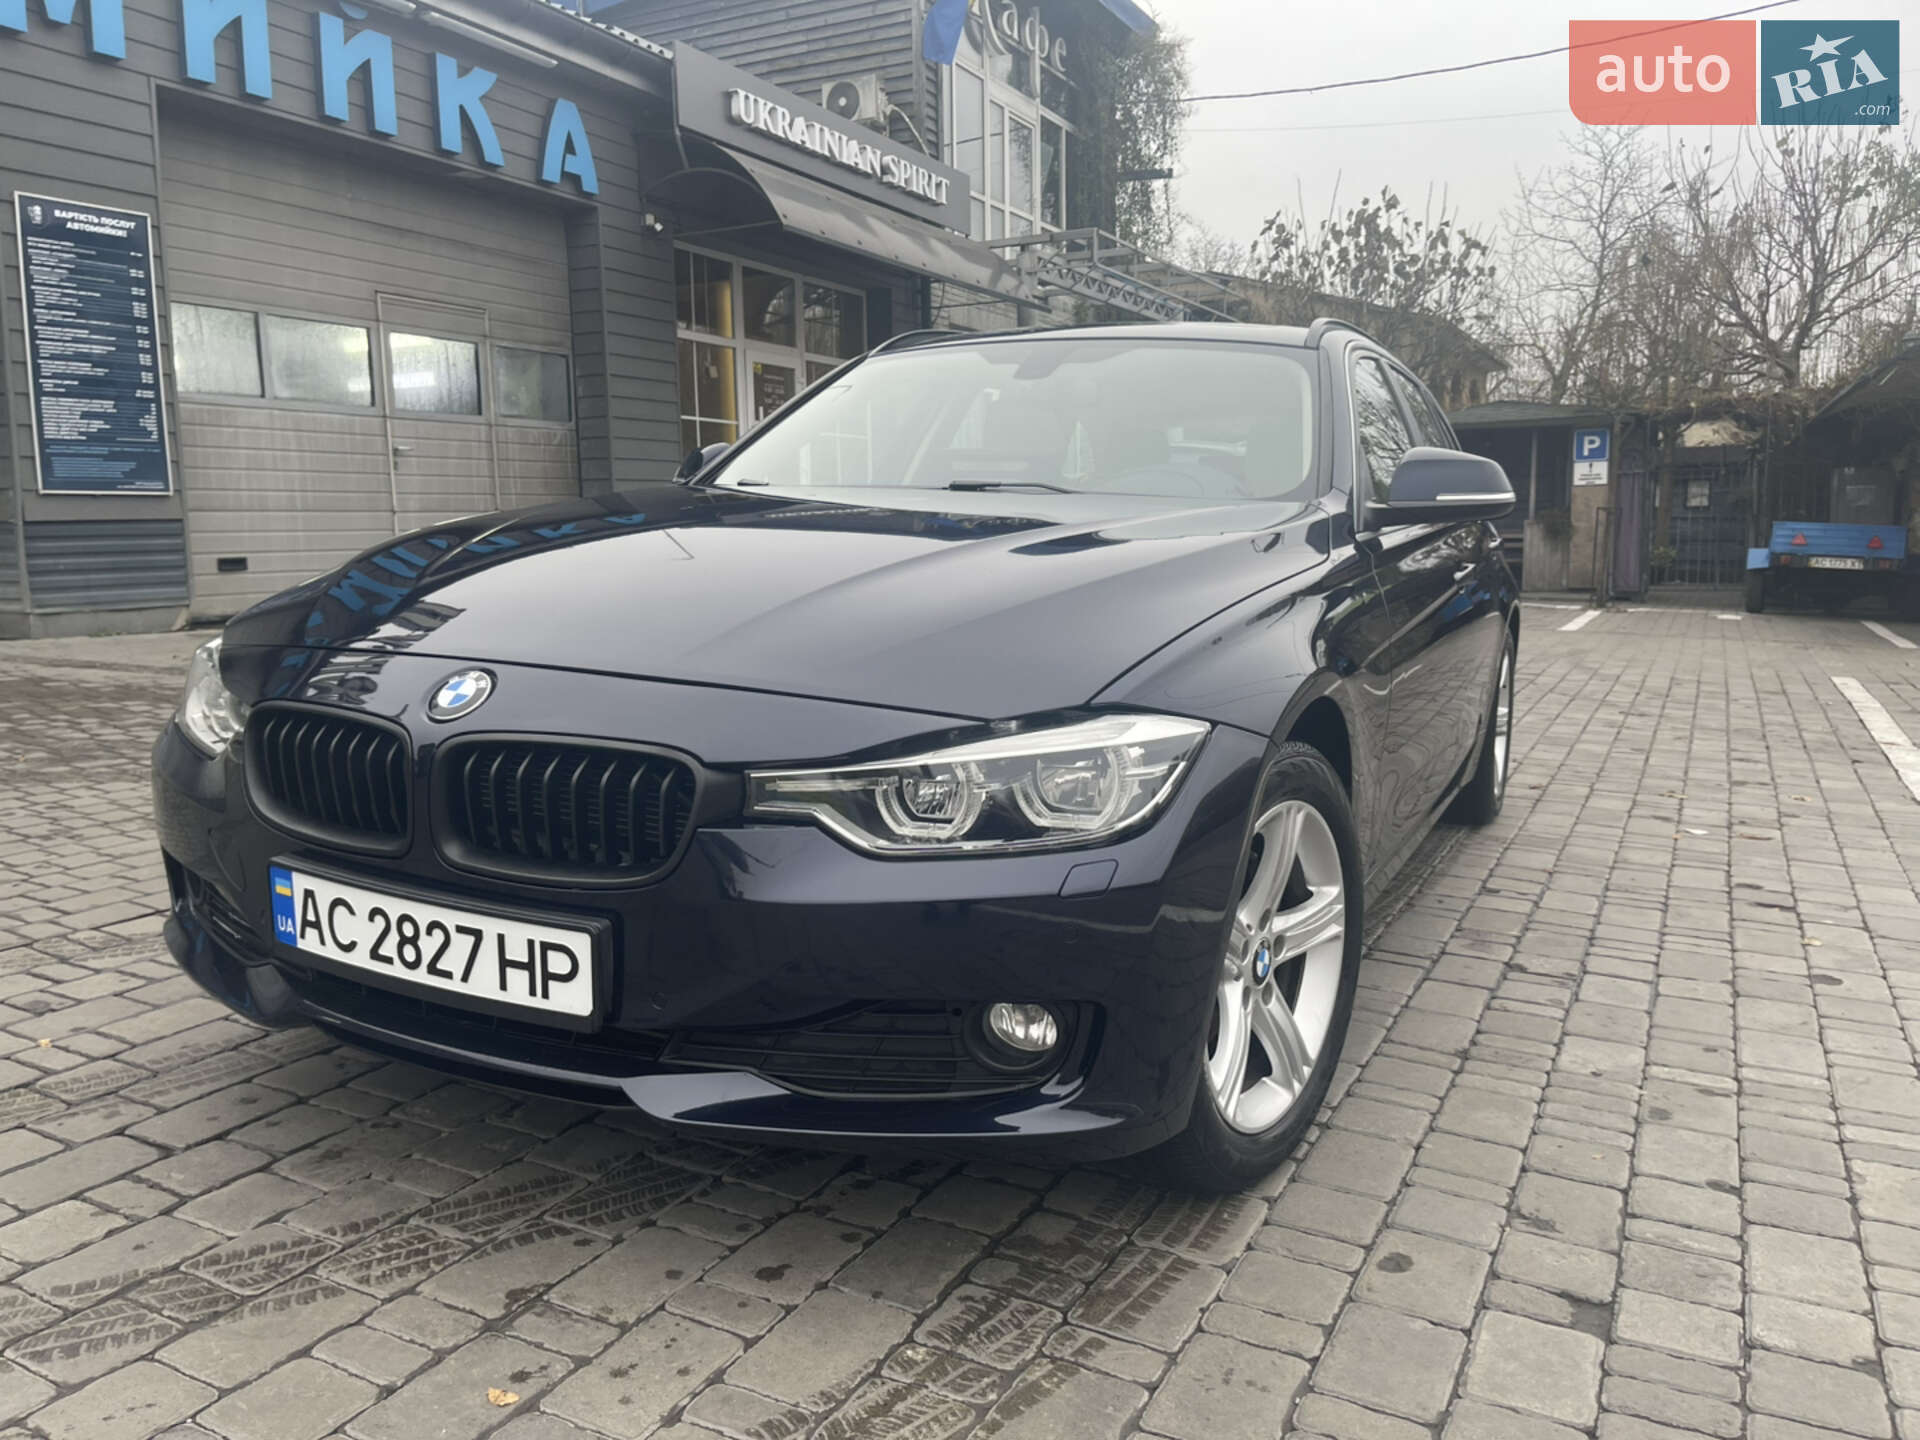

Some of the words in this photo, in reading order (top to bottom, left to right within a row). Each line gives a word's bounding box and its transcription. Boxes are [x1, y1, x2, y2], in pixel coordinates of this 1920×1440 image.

[729, 88, 882, 177] UKRAINIAN
[882, 155, 950, 205] SPIRIT
[1583, 436, 1601, 456] P
[277, 914, 295, 934] UA
[299, 888, 358, 953] AC
[368, 906, 483, 984] 2827
[497, 932, 580, 1000] HP
